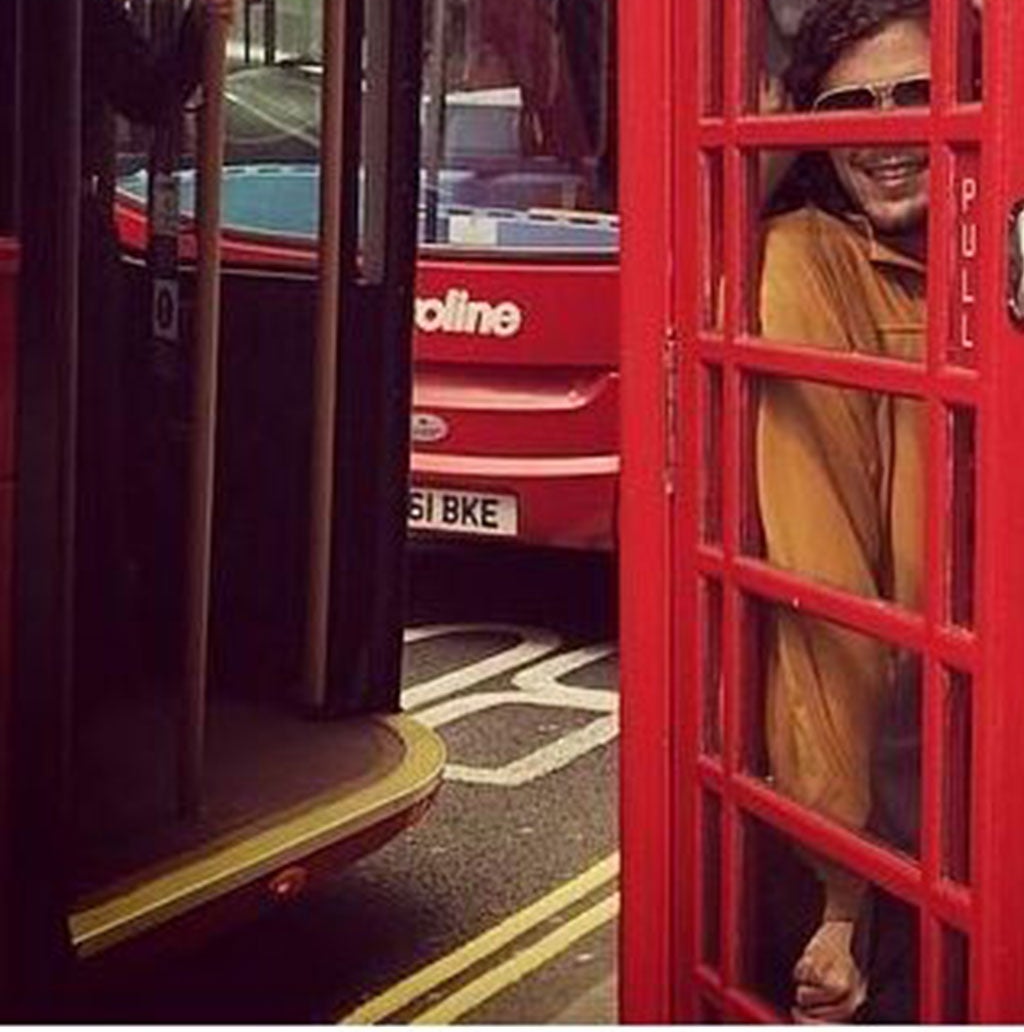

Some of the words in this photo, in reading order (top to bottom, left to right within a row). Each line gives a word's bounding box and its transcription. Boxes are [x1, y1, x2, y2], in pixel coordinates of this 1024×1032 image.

[961, 178, 977, 348] PULL
[414, 288, 521, 337] oline
[409, 493, 434, 523] 61
[442, 494, 499, 528] BKE
